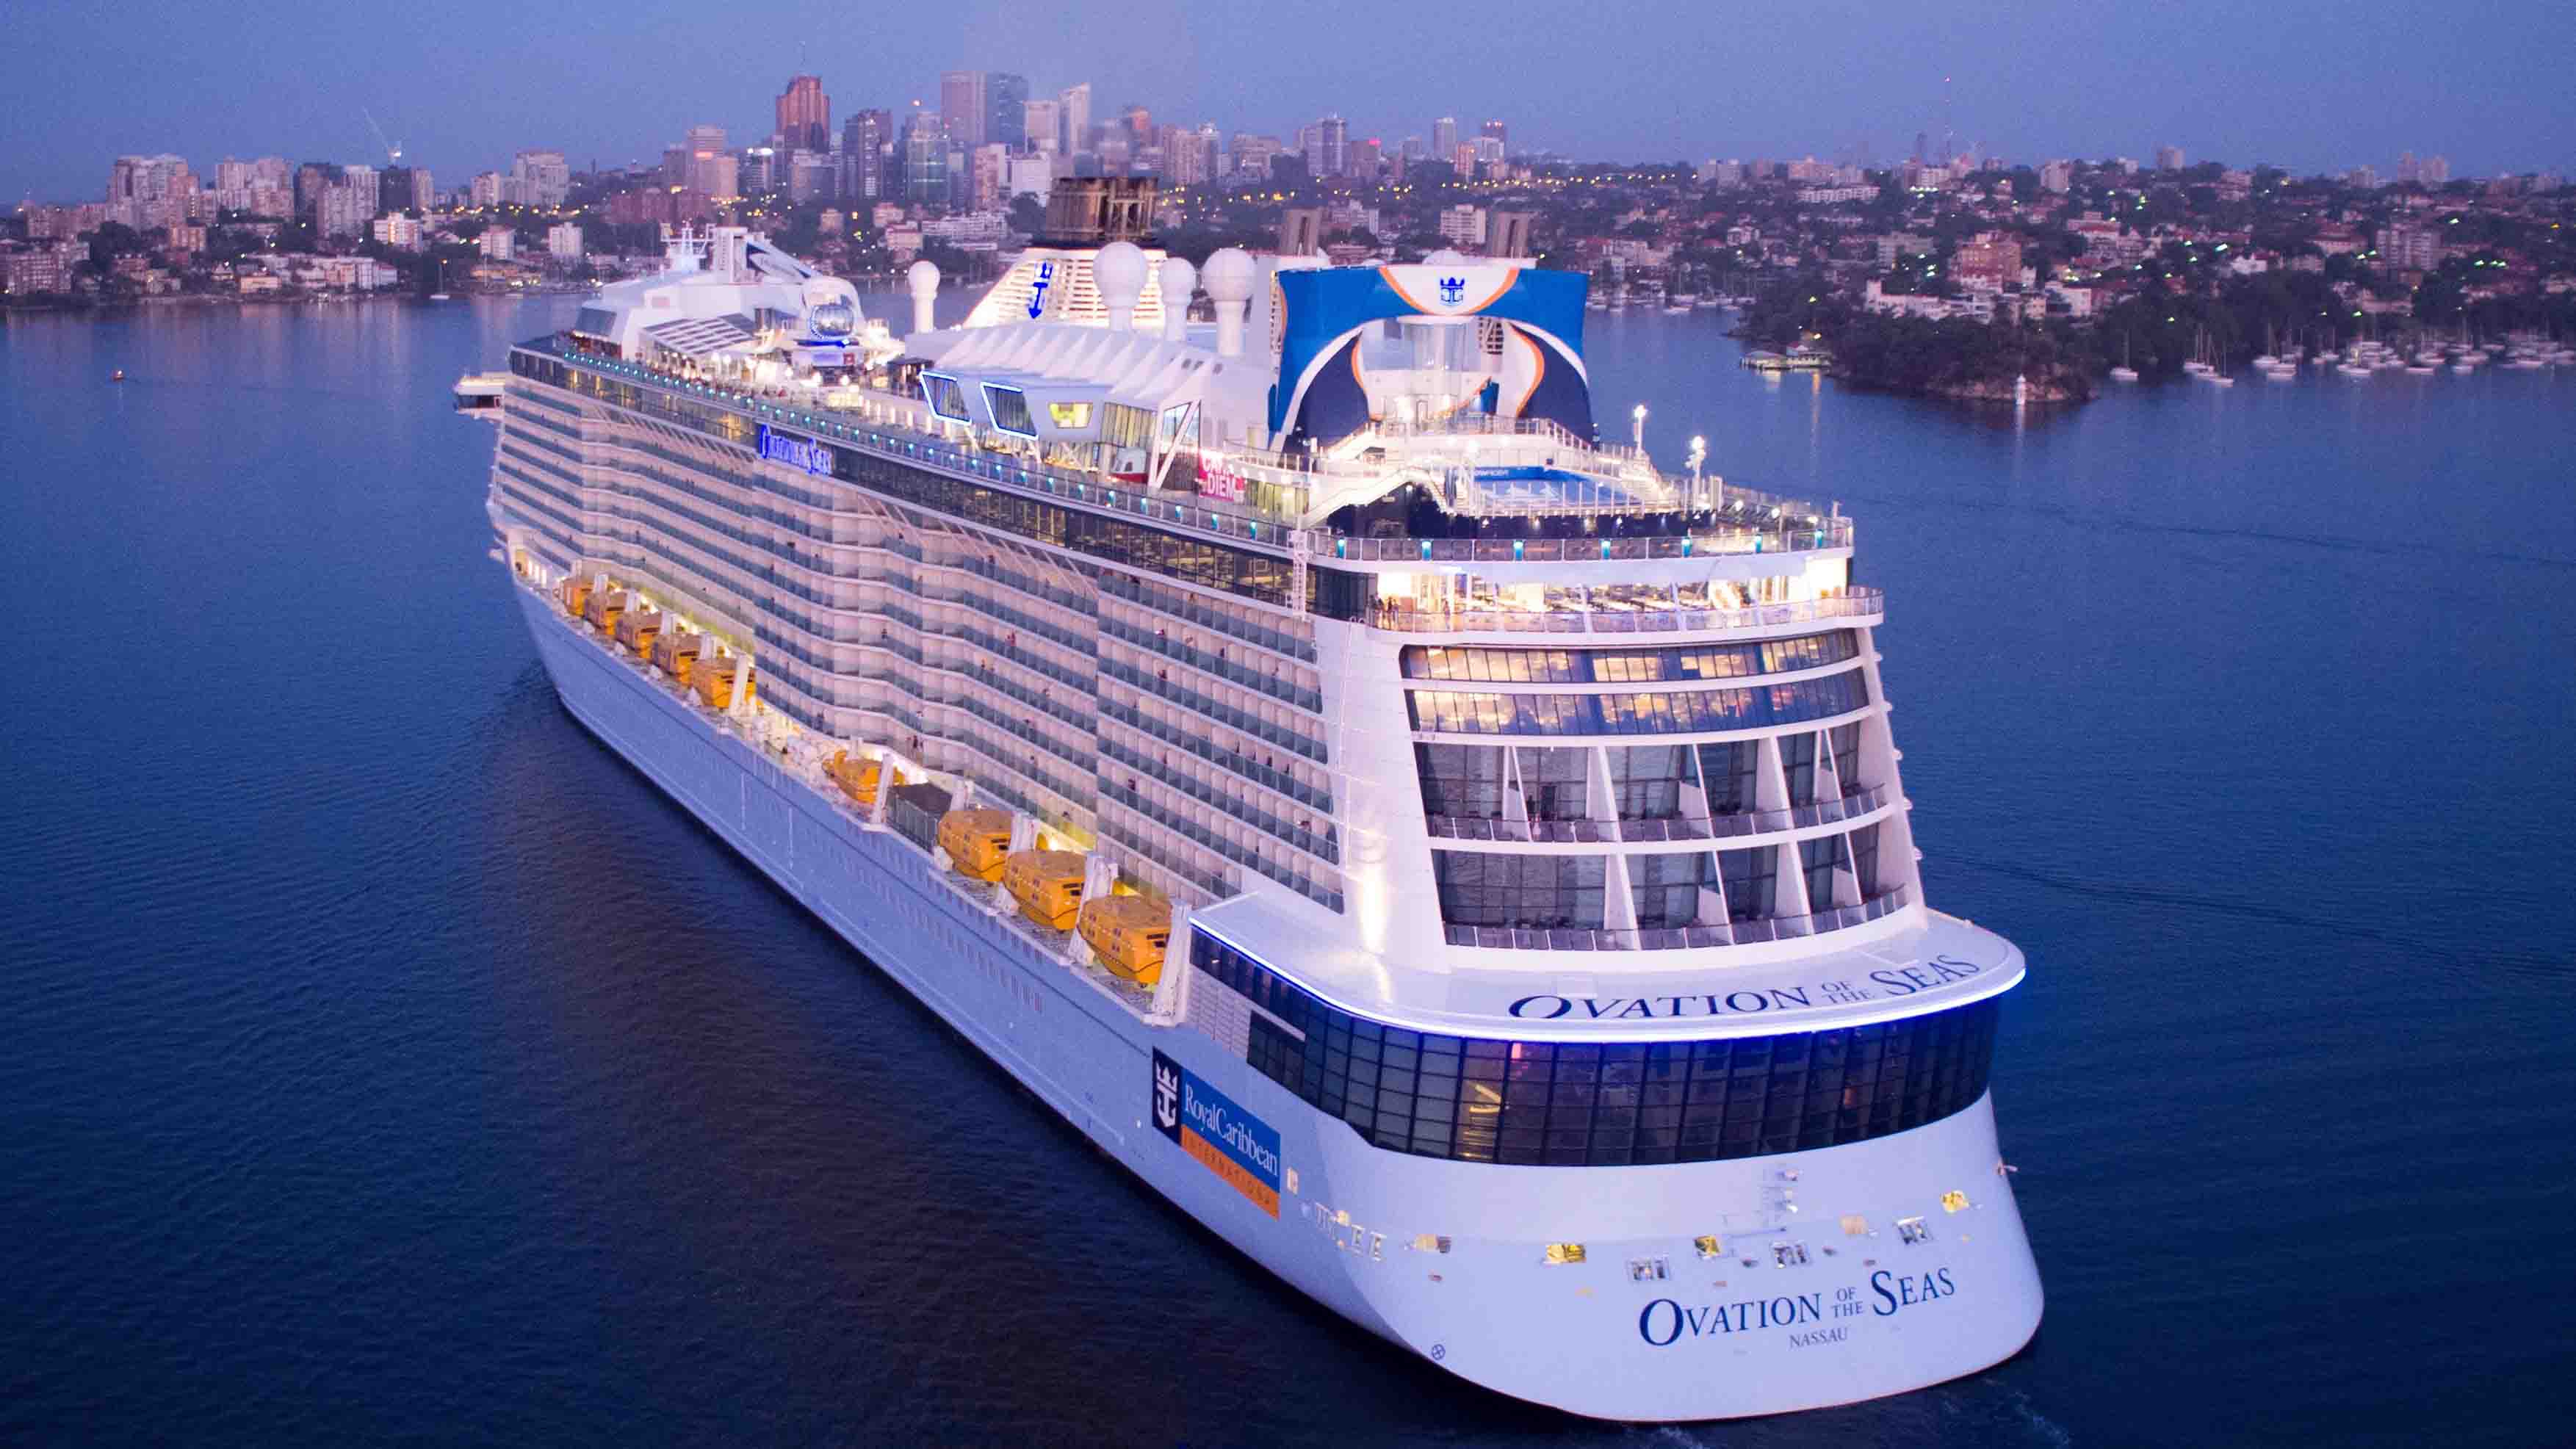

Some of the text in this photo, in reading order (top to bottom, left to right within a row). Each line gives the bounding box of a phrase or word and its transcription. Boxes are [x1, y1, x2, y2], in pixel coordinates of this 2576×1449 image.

[1508, 954, 1980, 1019] OVATION OF THE SEAS
[1639, 1268, 1955, 1346] OVATION OF THE SEAS
[1789, 1326, 1848, 1349] NASSAU
